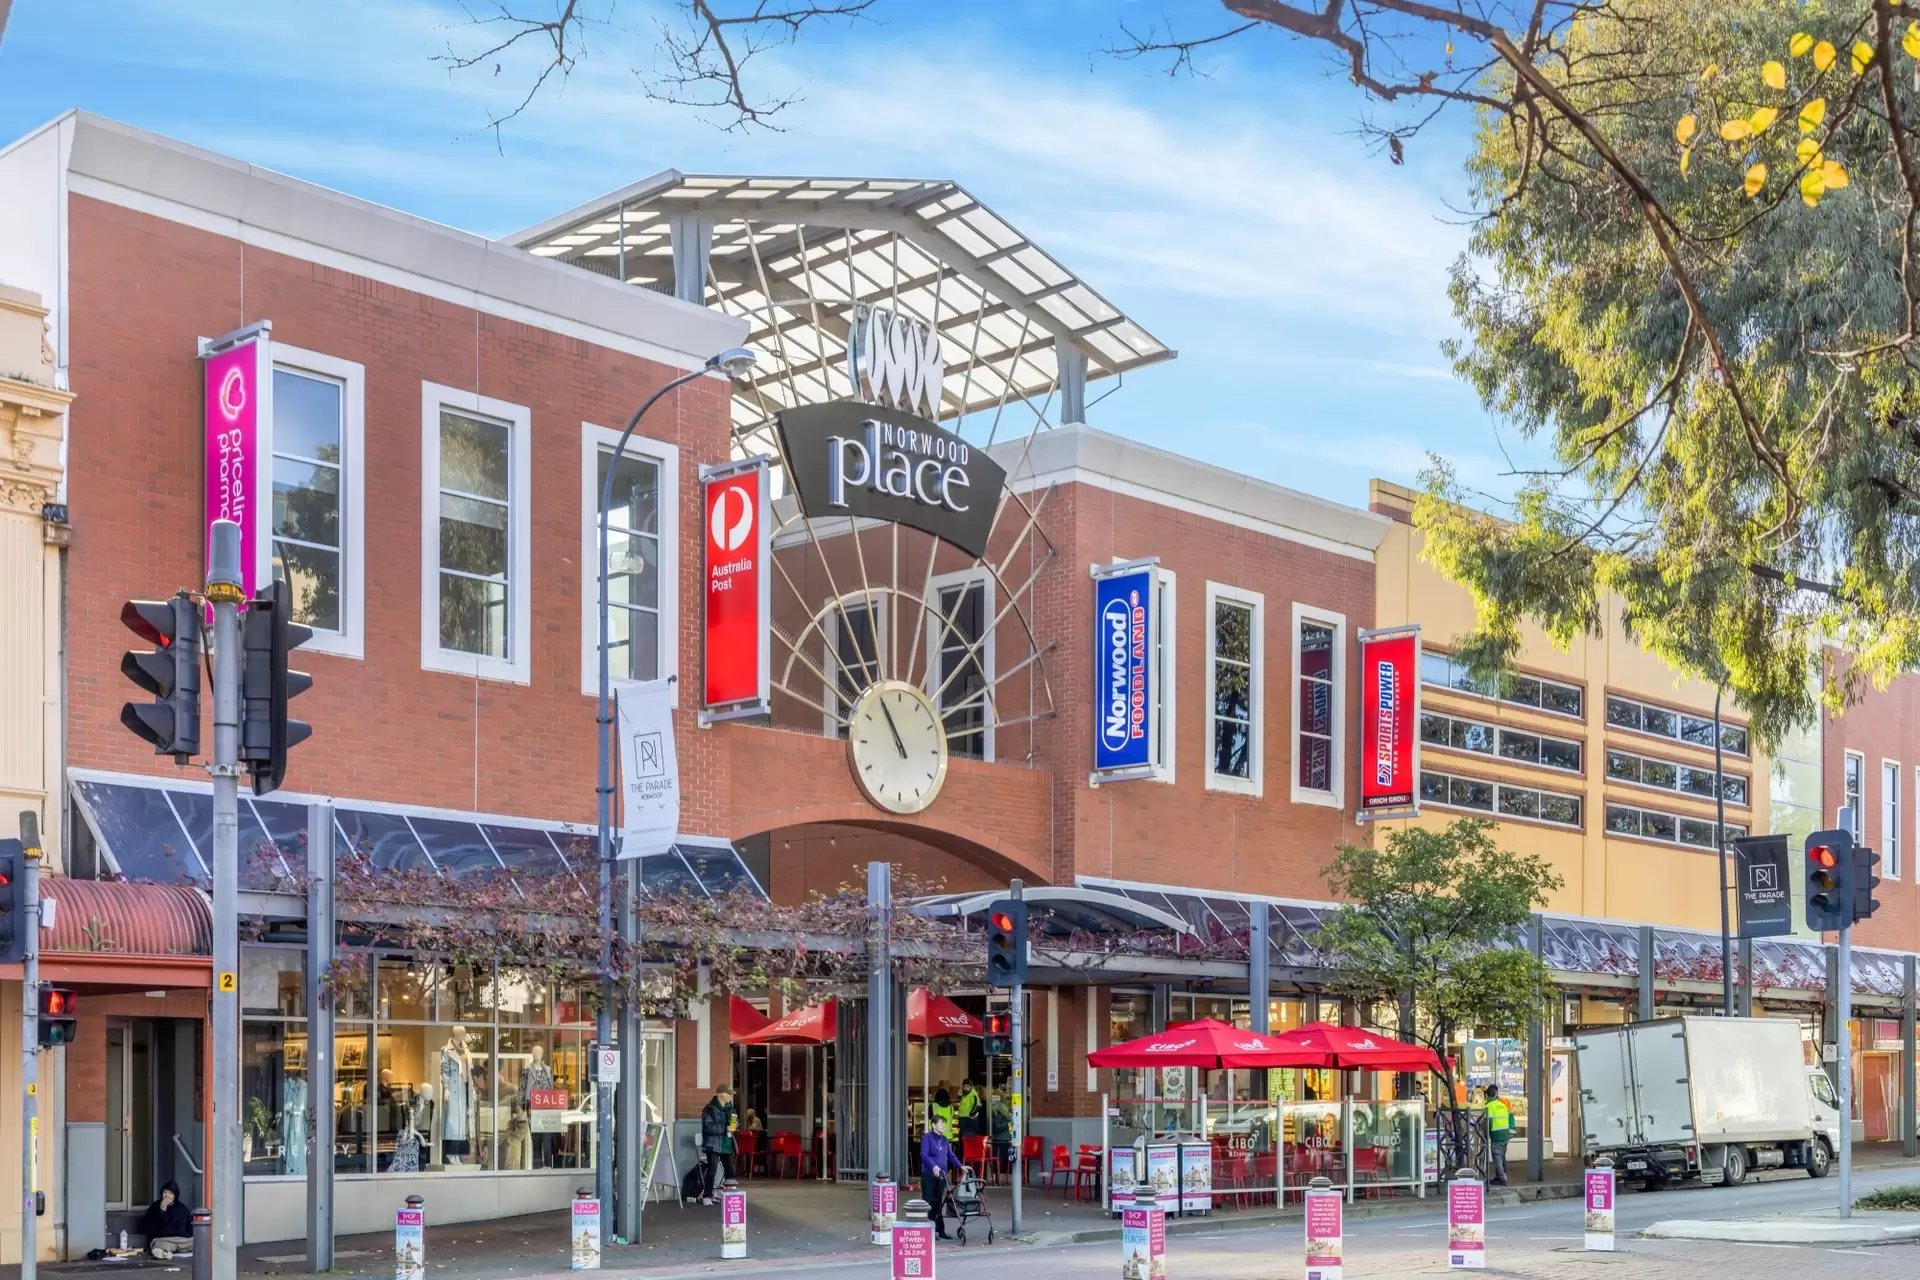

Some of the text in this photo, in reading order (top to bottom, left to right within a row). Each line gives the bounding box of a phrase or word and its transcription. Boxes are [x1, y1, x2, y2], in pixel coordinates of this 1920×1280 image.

[884, 422, 968, 465] NORWOOD
[827, 418, 970, 511] place
[229, 428, 245, 541] pricelin
[712, 558, 752, 578] Australia
[712, 577, 732, 593] Post
[1106, 612, 1127, 738] Norwood
[1132, 606, 1145, 739] FOODLAND
[1379, 662, 1393, 762] SPORTSPOWER
[630, 778, 673, 793] THE PARADE
[1759, 891, 1785, 899] PARADE
[223, 973, 233, 988] 2
[779, 1018, 807, 1028] CIBO
[938, 1016, 969, 1025] CIBO
[30, 1084, 36, 1094] 3
[535, 1094, 565, 1105] SALE
[1228, 1138, 1255, 1150] CIBO
[1305, 1136, 1329, 1148] CIBO
[1373, 1135, 1397, 1146] CIBO
[1128, 1211, 1142, 1219] SHOP
[1125, 1234, 1146, 1244] EUROPE
